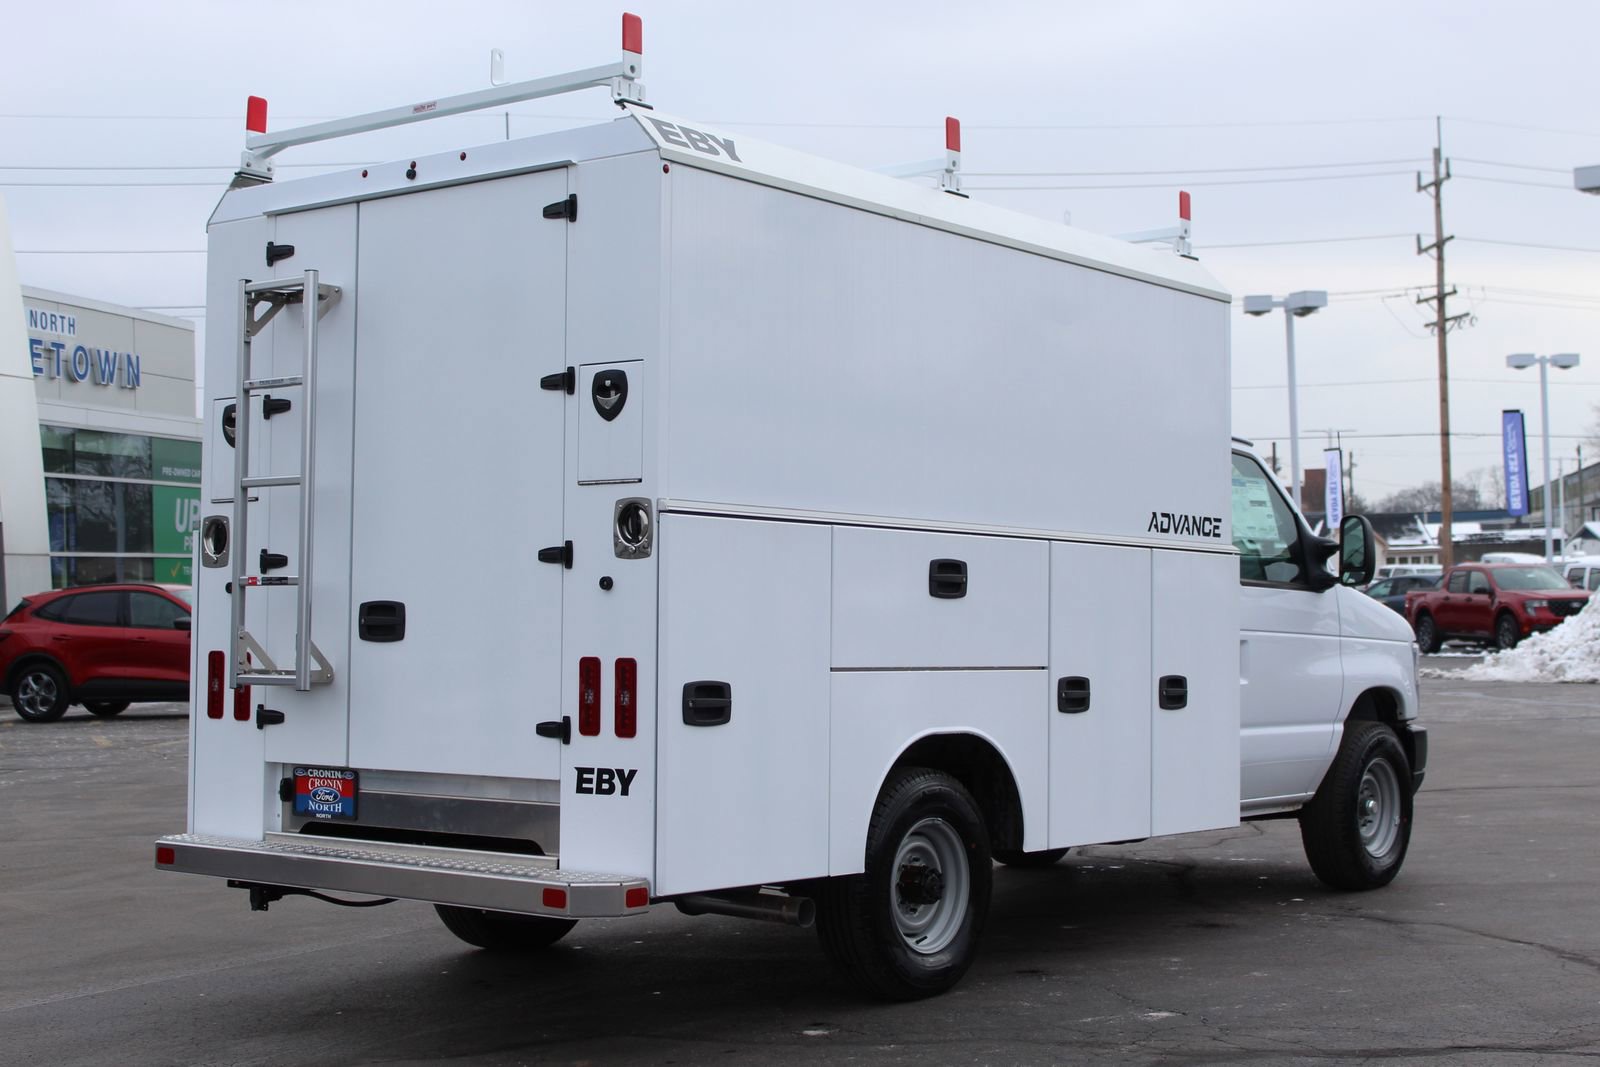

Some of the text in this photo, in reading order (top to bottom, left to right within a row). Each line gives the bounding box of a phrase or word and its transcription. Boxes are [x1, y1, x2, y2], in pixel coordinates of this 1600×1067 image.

[642, 115, 742, 162] EBY
[29, 309, 76, 335] NORTH
[29, 338, 140, 387] ETOWN
[1147, 511, 1222, 538] ADVANCE
[307, 769, 341, 778] CRONIN
[308, 778, 342, 792] CRONIN
[574, 766, 638, 797] EBY
[308, 799, 342, 812] NORTH
[315, 789, 335, 802] Ford
